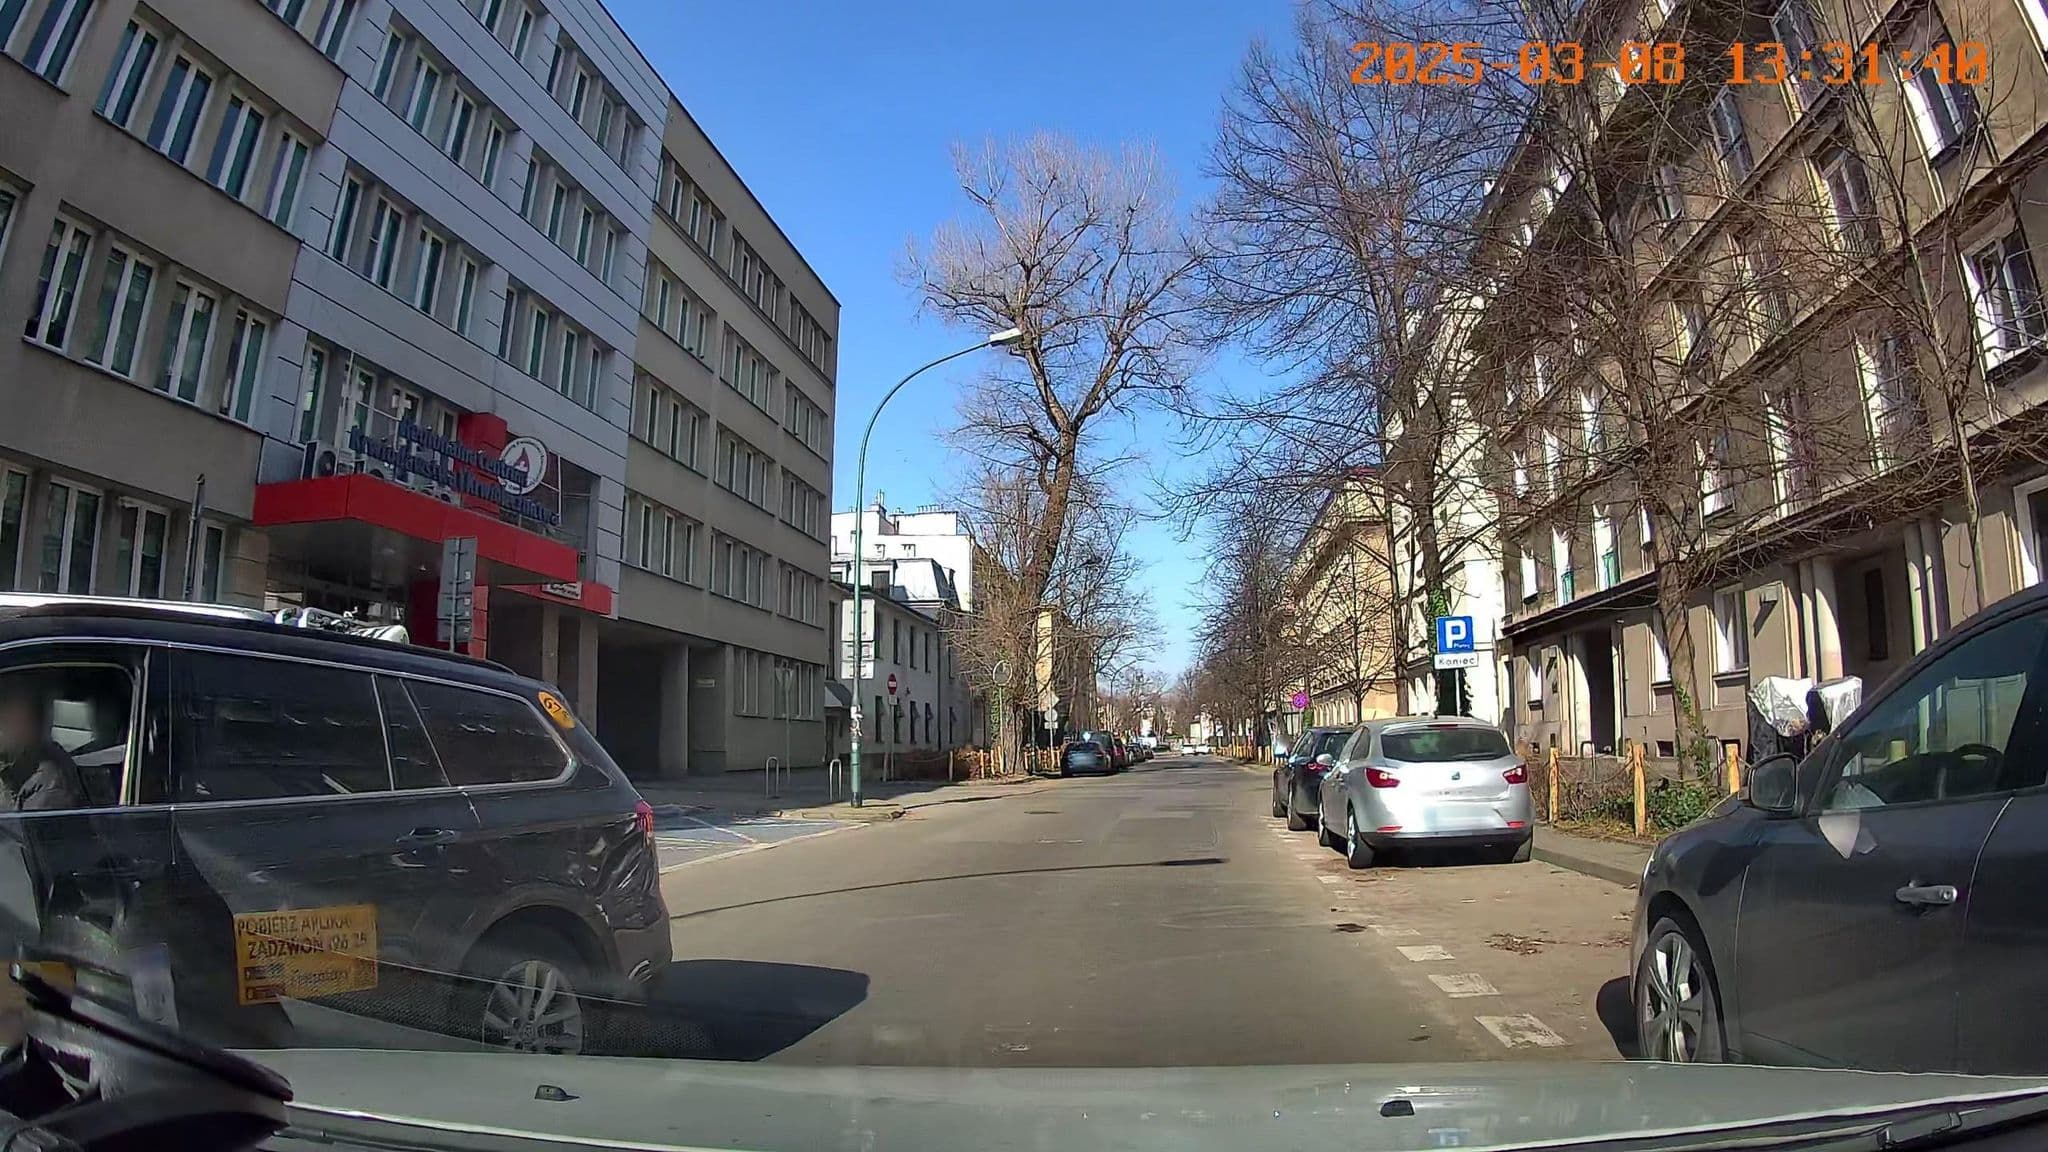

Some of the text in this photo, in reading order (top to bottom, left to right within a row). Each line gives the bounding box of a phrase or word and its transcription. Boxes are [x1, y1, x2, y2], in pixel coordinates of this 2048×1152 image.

[1445, 620, 1467, 649] P
[1438, 656, 1475, 666] Koniec
[238, 915, 299, 937] POBIERZ
